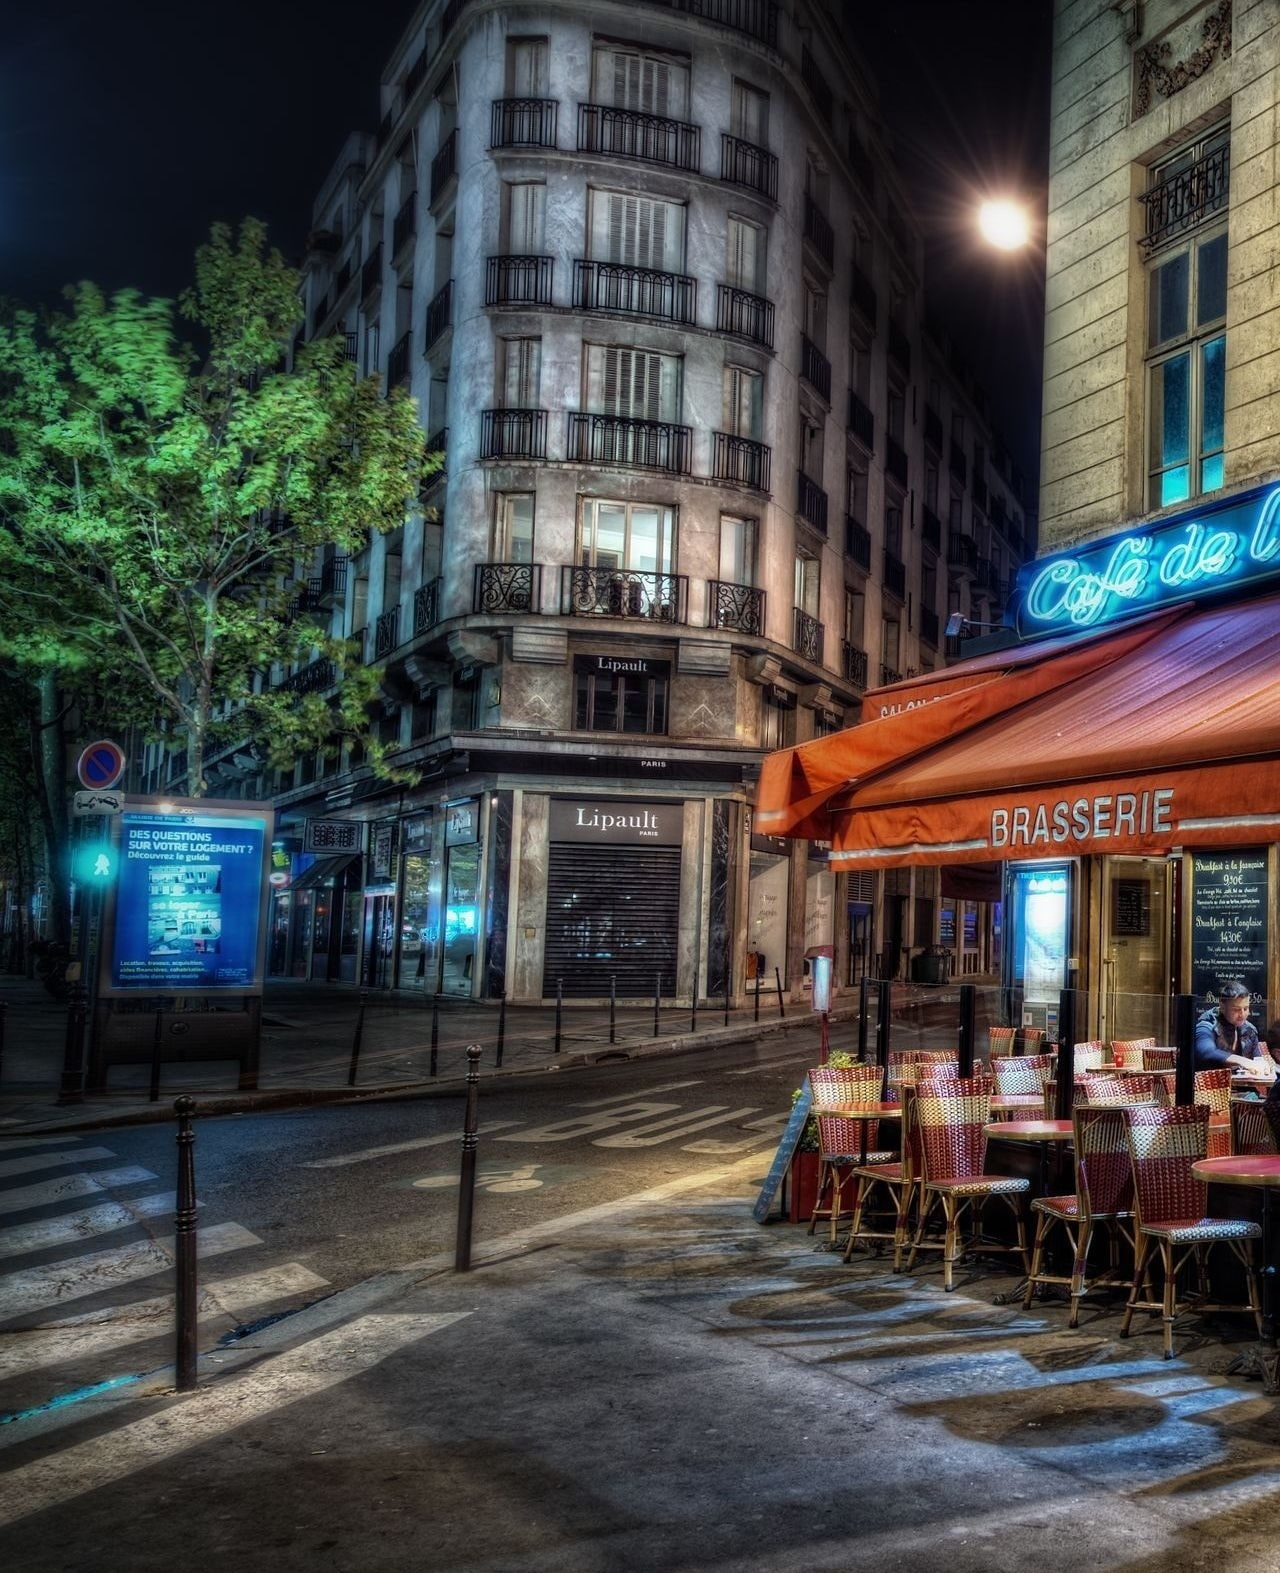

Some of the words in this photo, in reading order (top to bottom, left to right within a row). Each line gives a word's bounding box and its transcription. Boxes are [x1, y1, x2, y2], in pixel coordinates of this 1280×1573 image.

[1027, 536, 1154, 627] Café
[1159, 522, 1244, 587] de
[597, 656, 648, 673] Lipault
[641, 760, 667, 768] PARIS
[576, 807, 660, 832] Lipault
[991, 787, 1176, 849] BRASSERIE
[129, 830, 150, 839] DES
[152, 831, 212, 842] QUESTIONS
[128, 841, 151, 850] SUR
[151, 841, 188, 851] VOTRE
[190, 843, 245, 854] LOGEMENT
[128, 851, 175, 861] Découvrez
[176, 852, 184, 860] le
[185, 852, 210, 863] guide
